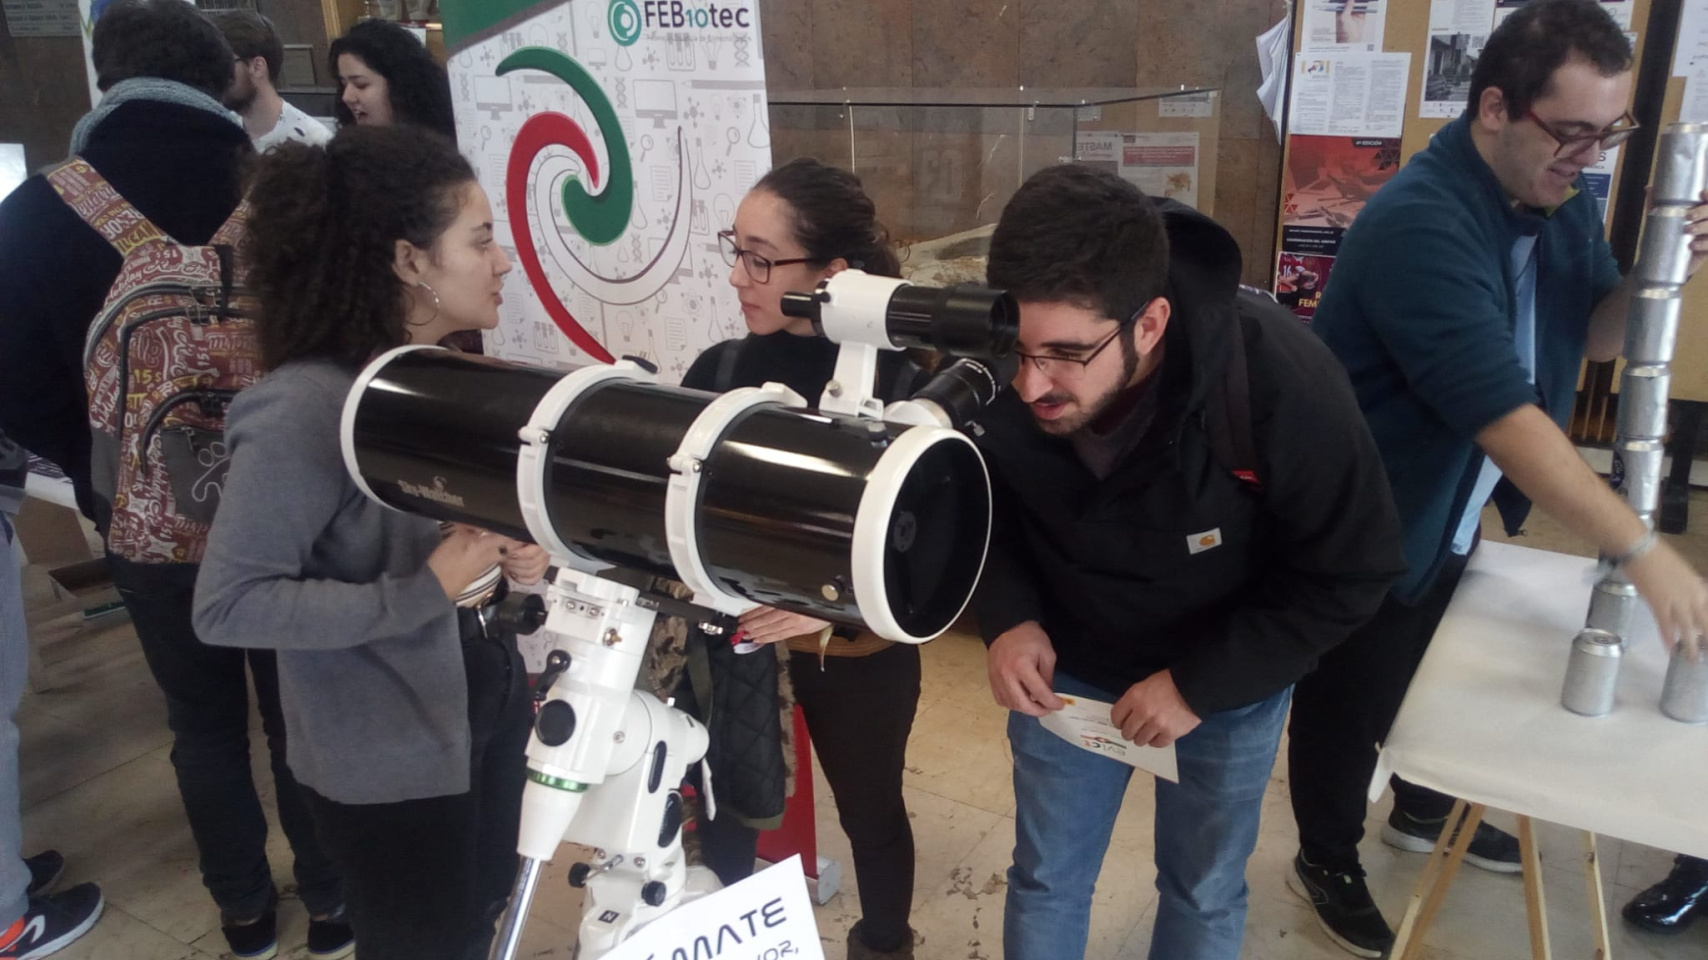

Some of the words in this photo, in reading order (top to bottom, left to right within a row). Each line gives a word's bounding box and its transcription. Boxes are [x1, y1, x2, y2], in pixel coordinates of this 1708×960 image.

[1298, 298, 1319, 308] FEM
[646, 897, 787, 960] MATE
[757, 940, 799, 960] OR,
